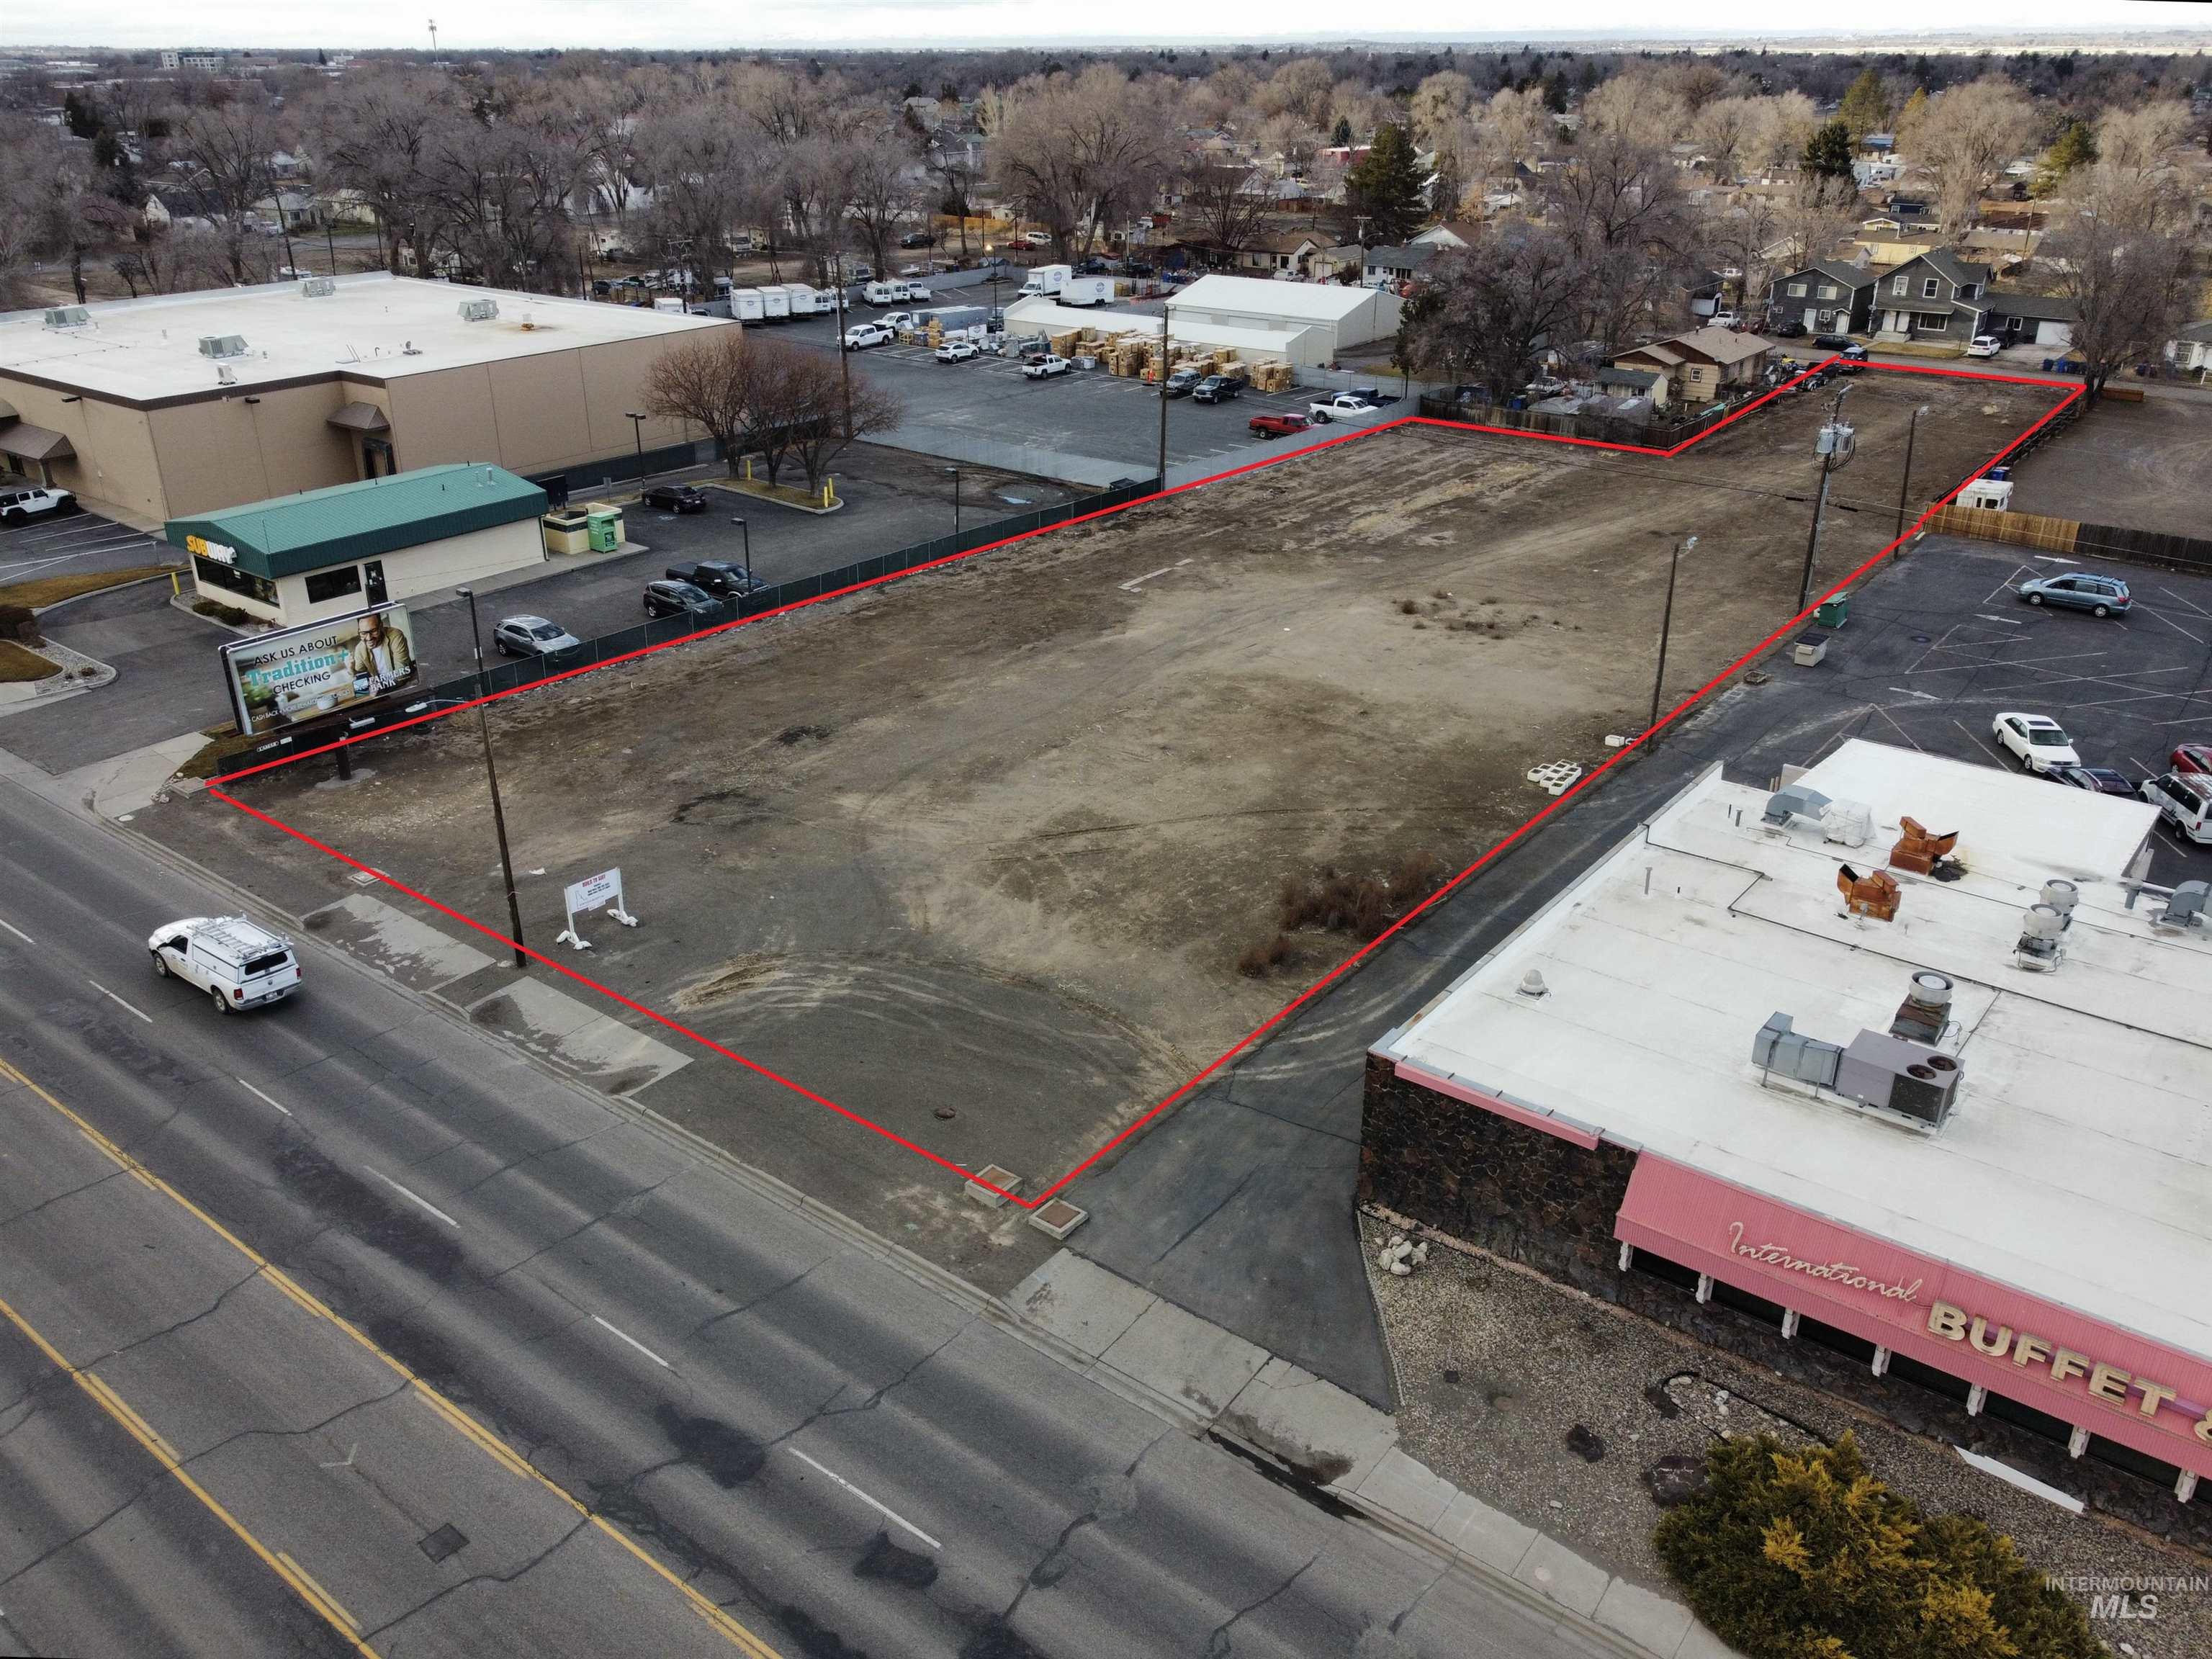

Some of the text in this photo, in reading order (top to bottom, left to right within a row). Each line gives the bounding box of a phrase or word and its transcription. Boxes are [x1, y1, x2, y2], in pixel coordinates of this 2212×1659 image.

[186, 535, 237, 565] SUBWAY
[254, 636, 338, 666] ASK US ABOUT
[245, 653, 336, 686] Tradition
[273, 671, 331, 694] CHECKING
[369, 666, 411, 685] FARMERS
[369, 678, 397, 692] BANK
[1728, 1221, 1923, 1301] International
[1928, 1299, 2177, 1419] BUFFET
